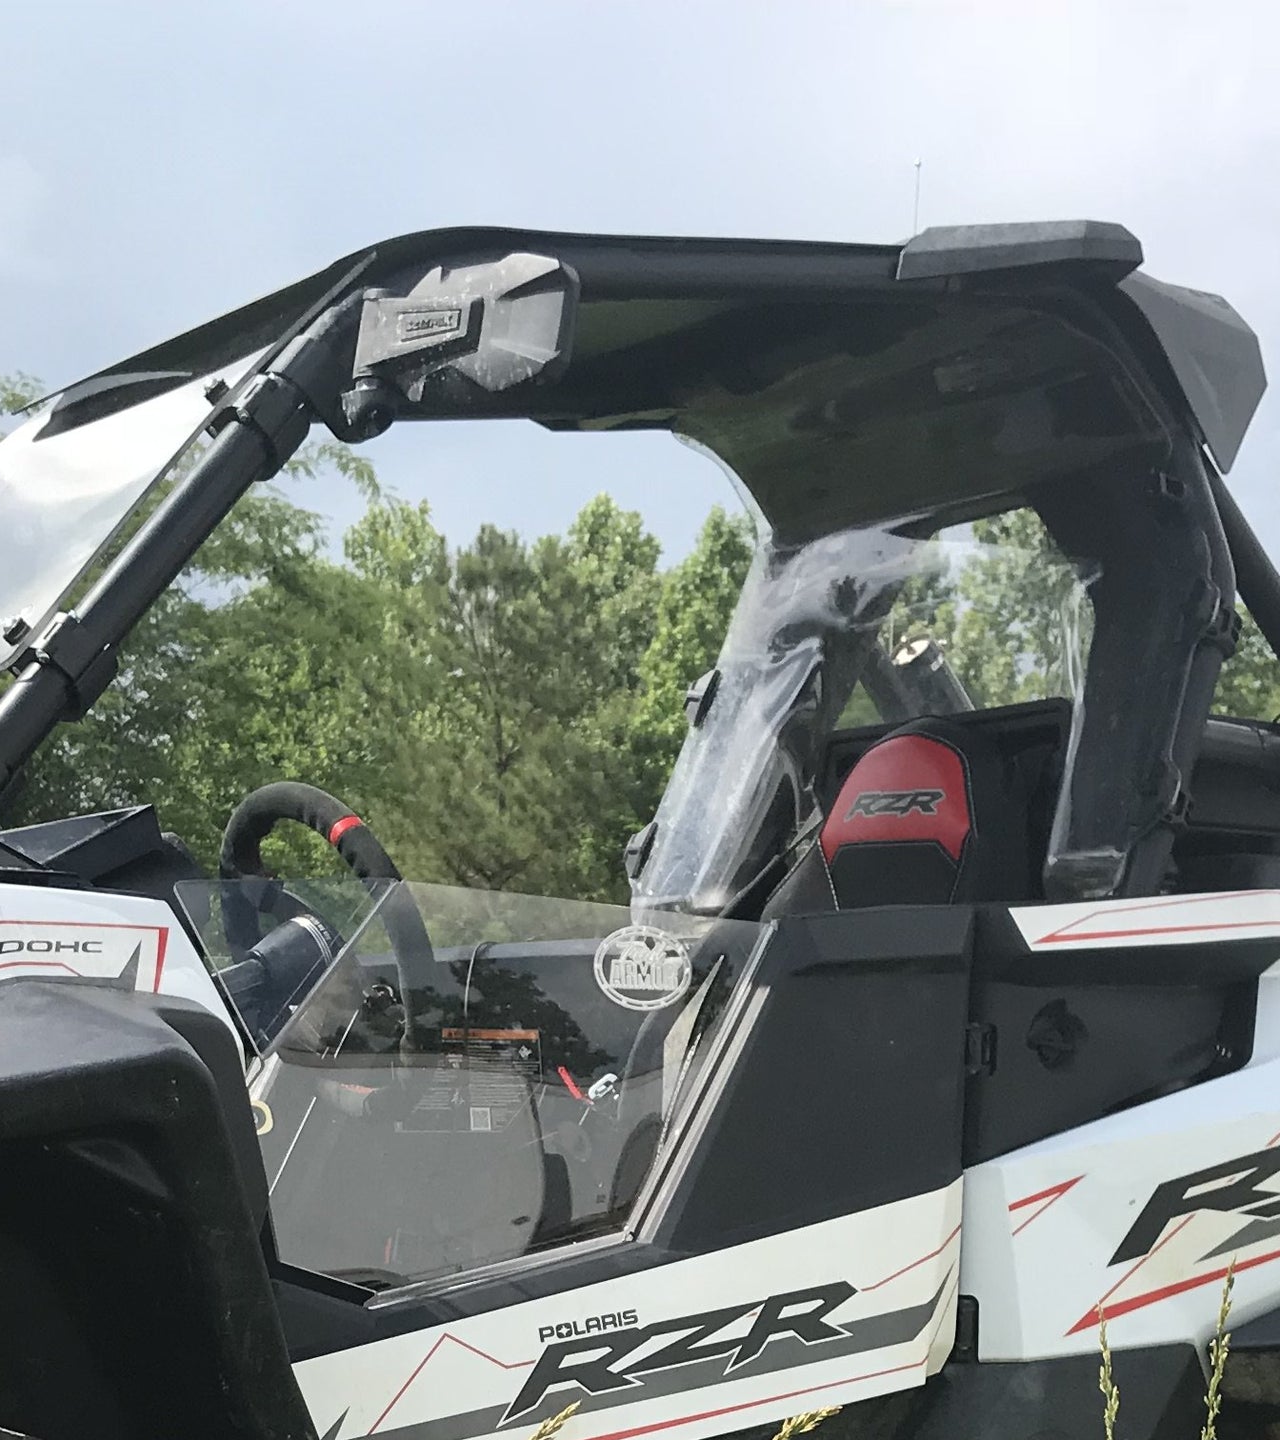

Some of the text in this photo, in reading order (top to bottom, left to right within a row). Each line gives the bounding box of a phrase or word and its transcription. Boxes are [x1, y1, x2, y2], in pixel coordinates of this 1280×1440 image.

[844, 788, 946, 823] RZR
[538, 1309, 639, 1343] POLARIS
[498, 1281, 859, 1426] RZR
